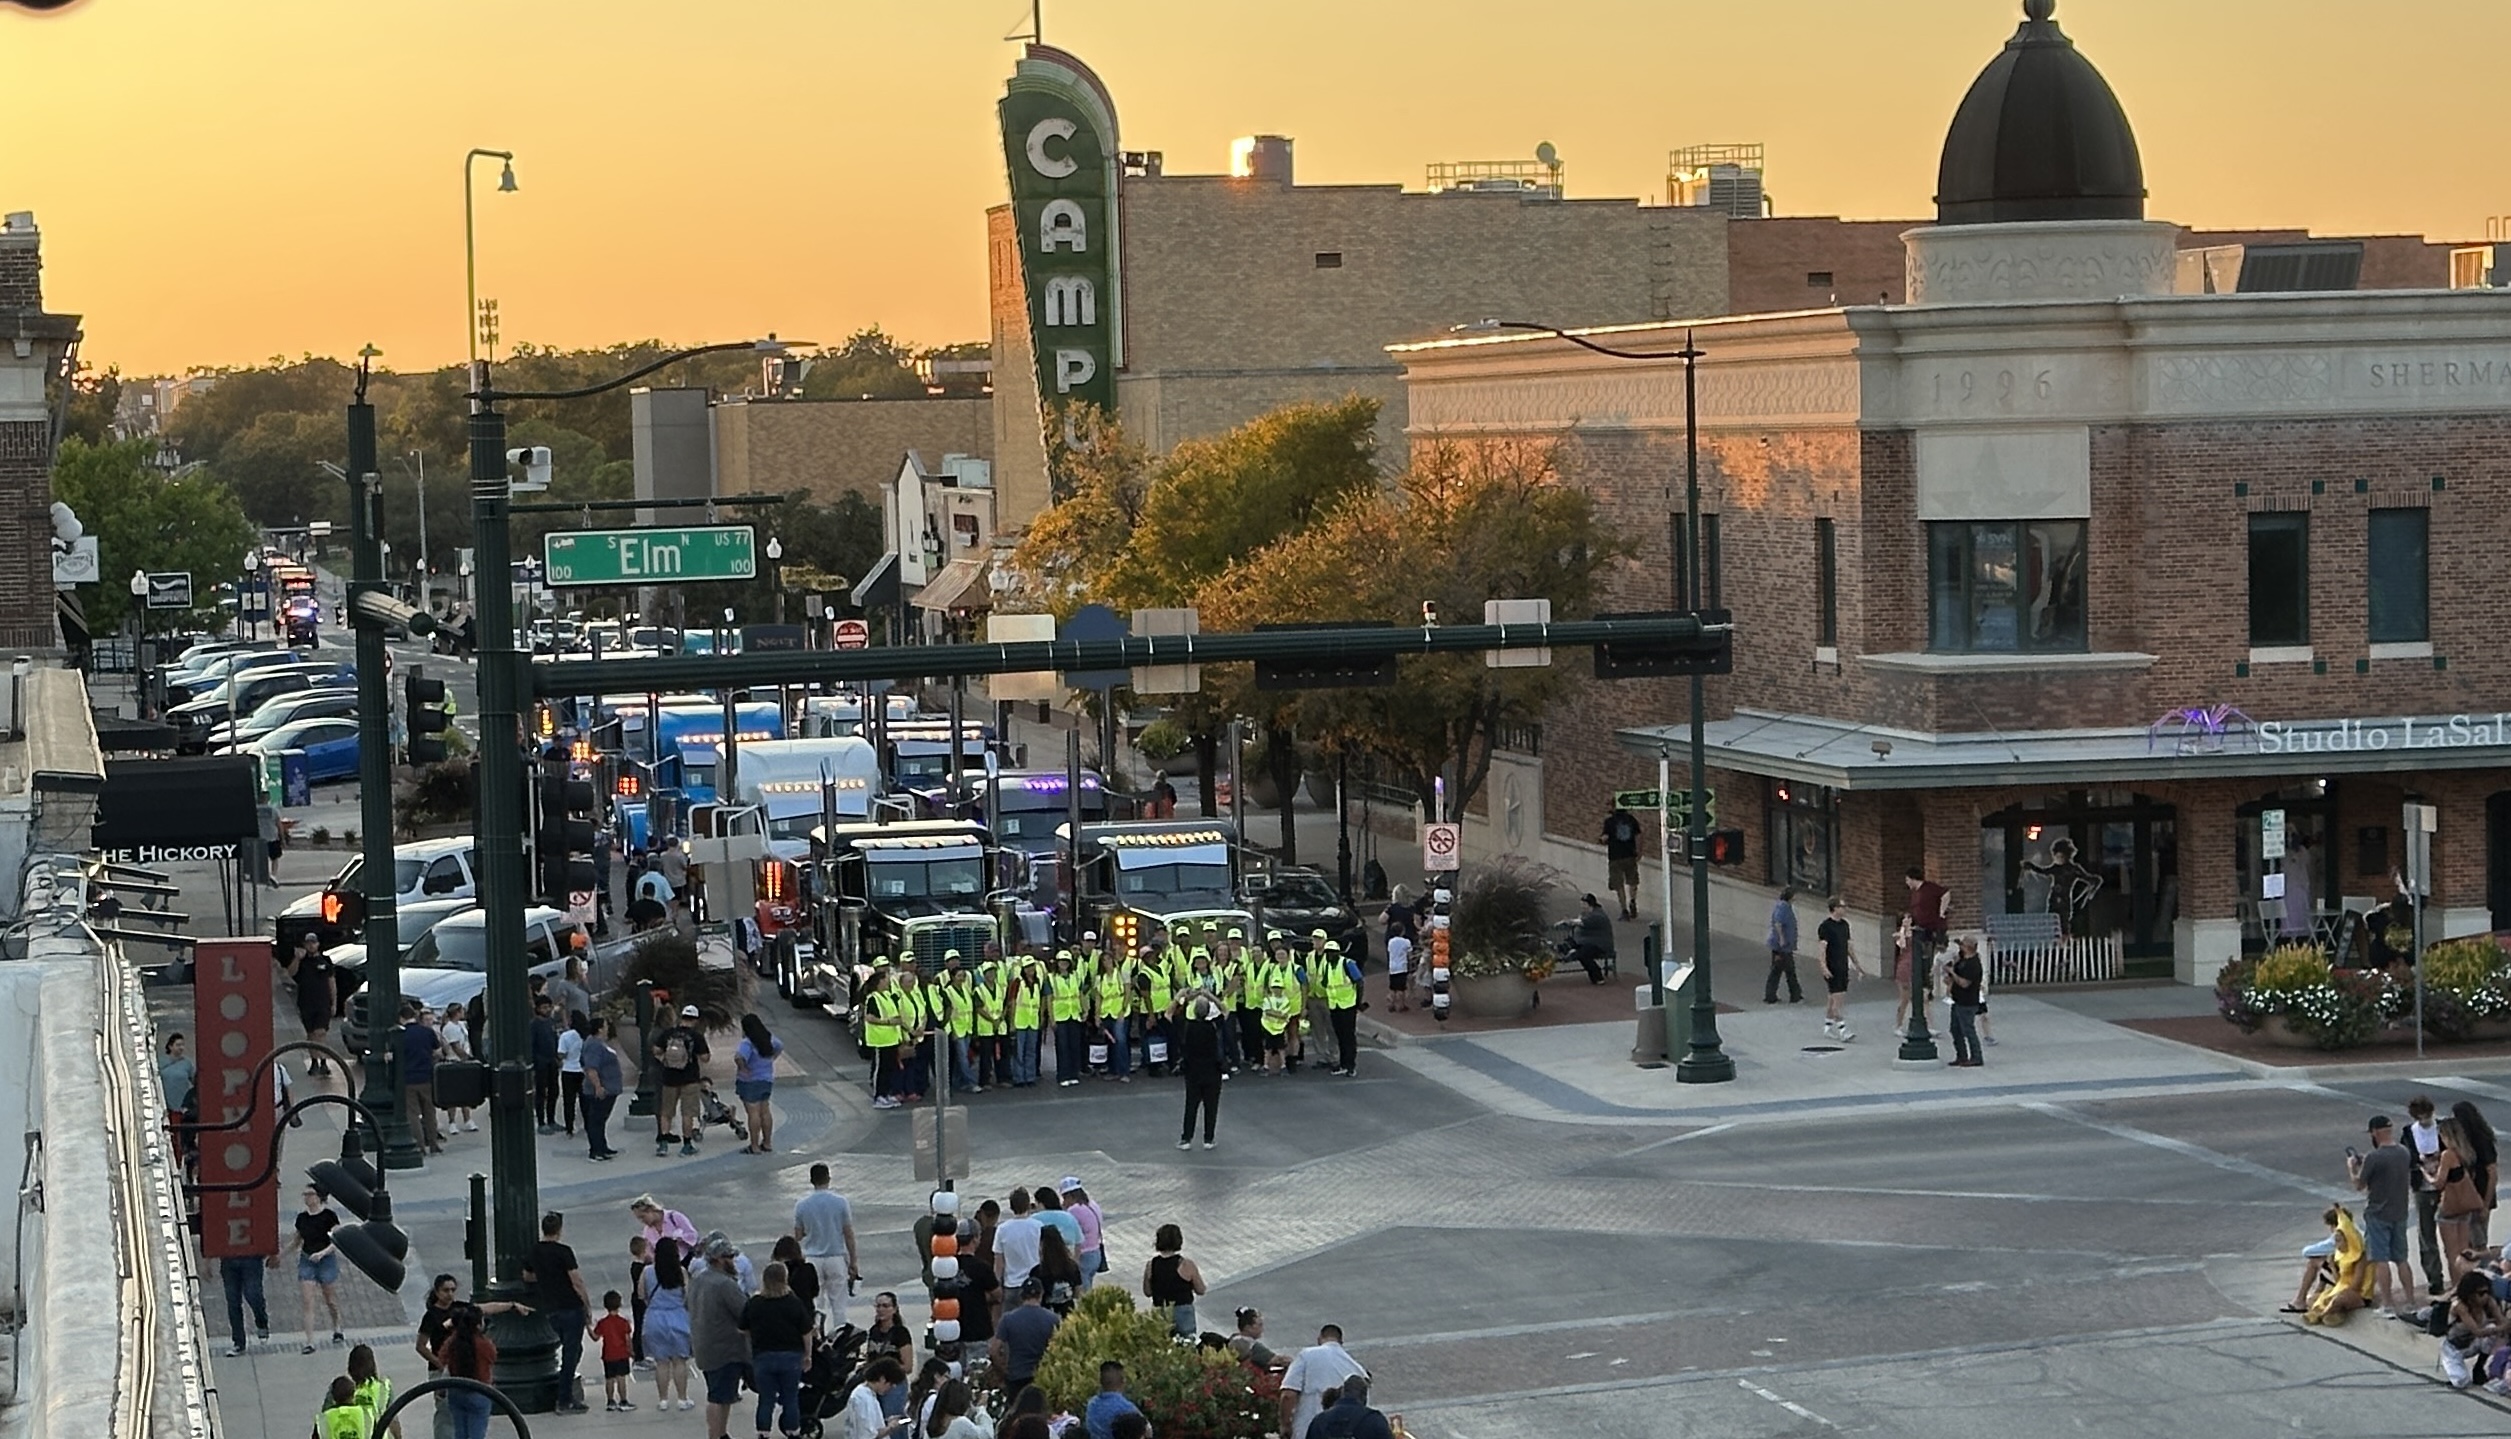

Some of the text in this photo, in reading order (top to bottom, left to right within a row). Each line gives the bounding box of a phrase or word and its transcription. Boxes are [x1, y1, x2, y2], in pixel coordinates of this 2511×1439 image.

[1026, 117, 1096, 454] CAMPU
[1933, 369, 2052, 402] 1996
[607, 533, 690, 575] S Elm N
[714, 531, 749, 546] US 77
[551, 565, 572, 580] 100
[730, 559, 750, 573] 100
[2259, 718, 2389, 754] Studio
[102, 844, 237, 863] HE HICKORY
[219, 955, 251, 1247] LOOPHOLE
